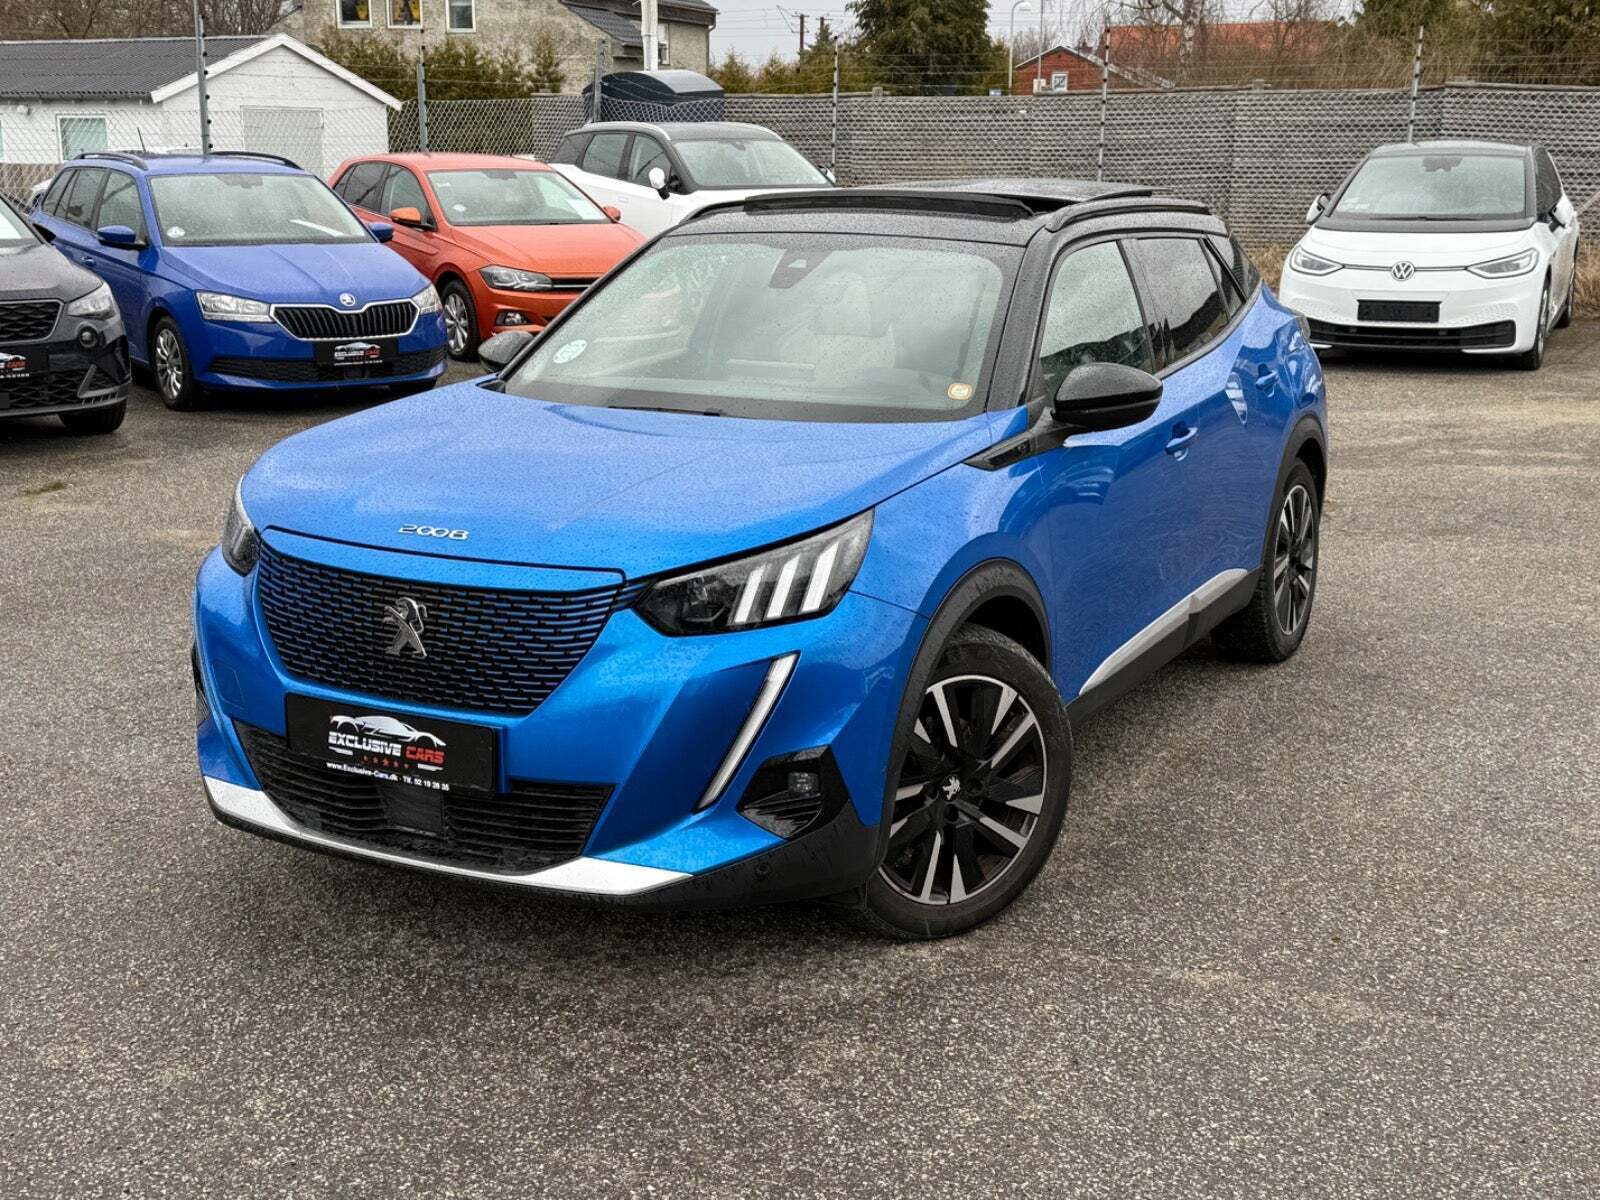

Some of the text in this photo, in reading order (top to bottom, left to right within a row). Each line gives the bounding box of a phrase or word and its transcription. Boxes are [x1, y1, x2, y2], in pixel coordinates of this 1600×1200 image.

[398, 523, 470, 540] 2008
[328, 731, 445, 765] EXCLUSIVE CARS
